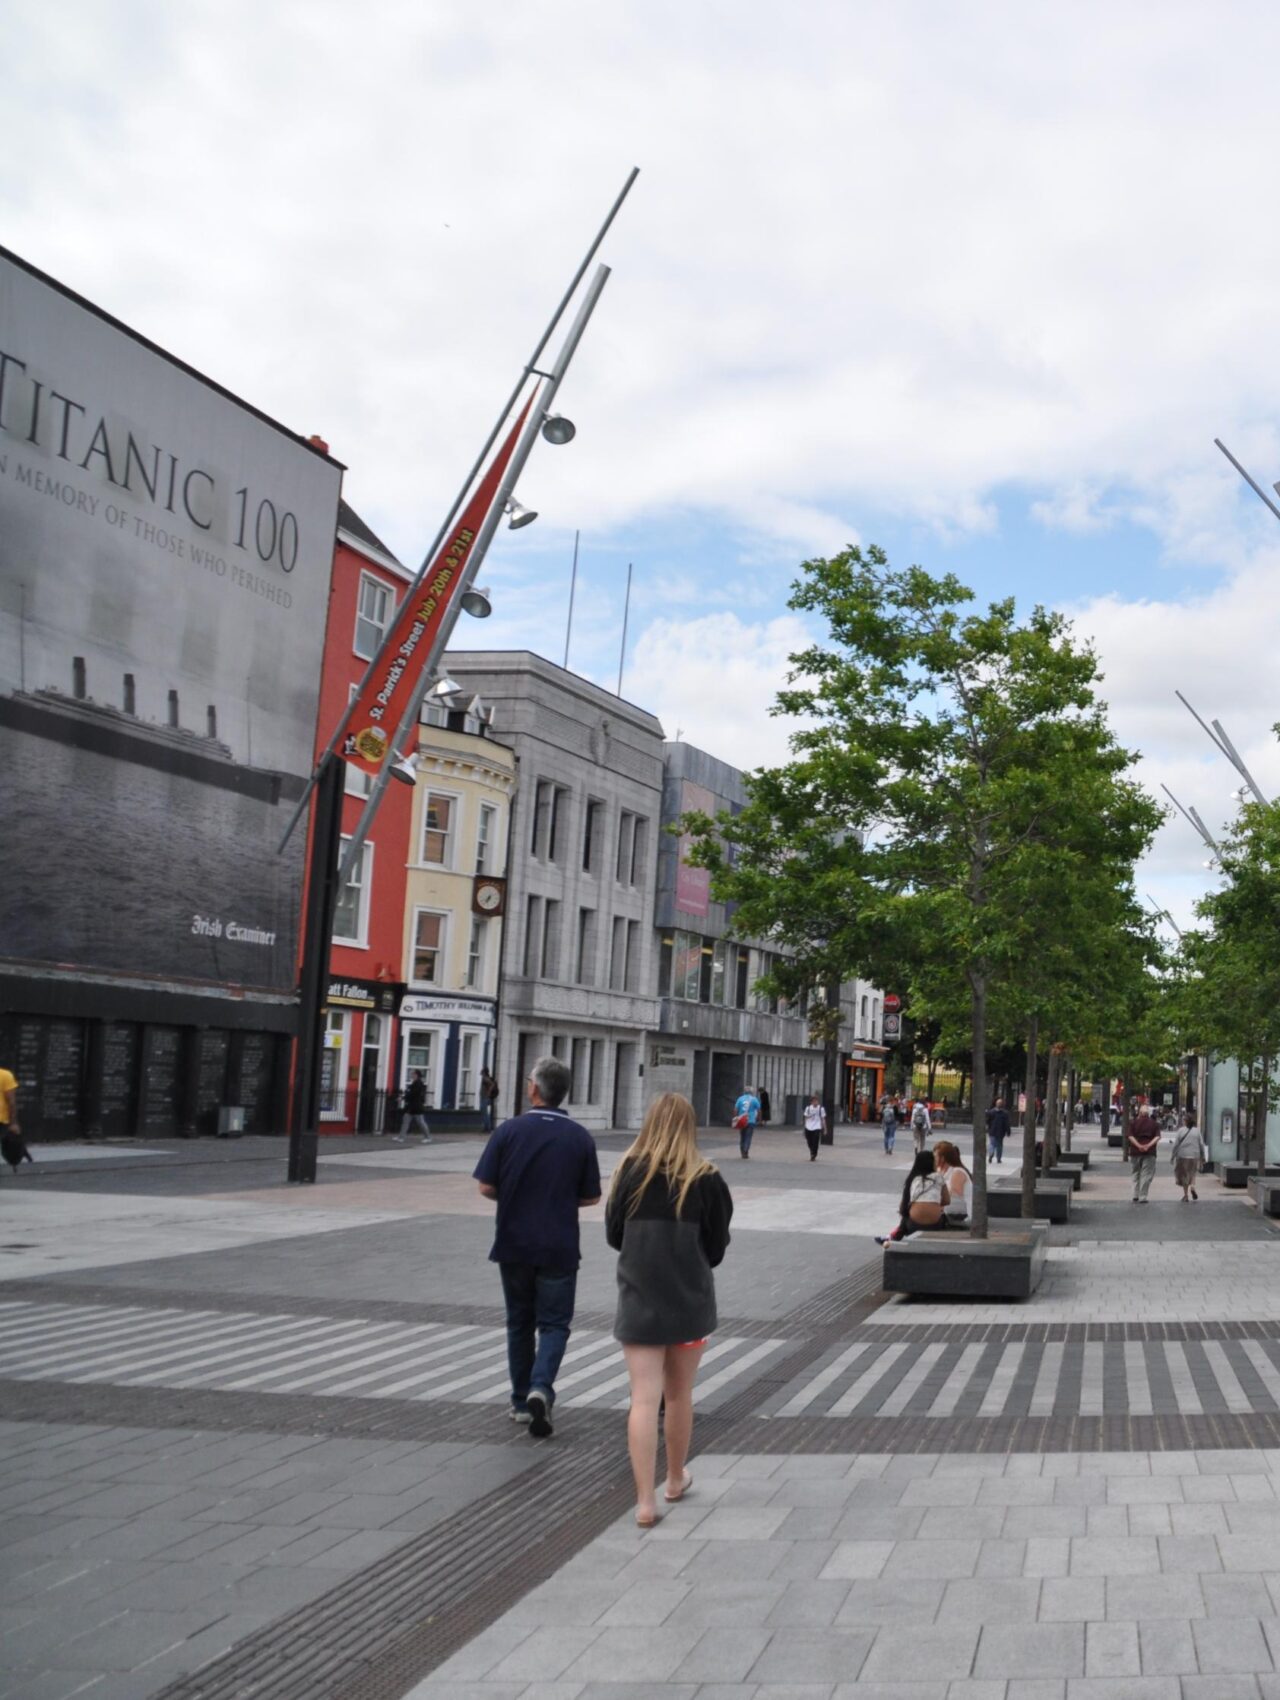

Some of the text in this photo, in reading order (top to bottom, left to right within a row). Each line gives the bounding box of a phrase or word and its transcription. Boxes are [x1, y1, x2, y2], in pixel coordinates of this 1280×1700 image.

[0, 353, 298, 573] TITANIC 100
[15, 464, 100, 516] MEMORY
[105, 504, 128, 529] OF
[134, 515, 185, 558] THOSE
[190, 544, 226, 576] WHO
[231, 566, 293, 609] PERISHED
[451, 529, 474, 555] 21st
[445, 556, 459, 568] &
[429, 568, 453, 597] 20th
[417, 597, 437, 622] July
[399, 621, 425, 657] Street
[377, 656, 407, 705] Patrick's
[191, 914, 276, 946] Irish Examiner
[415, 1000, 458, 1011] TIMOTHY
